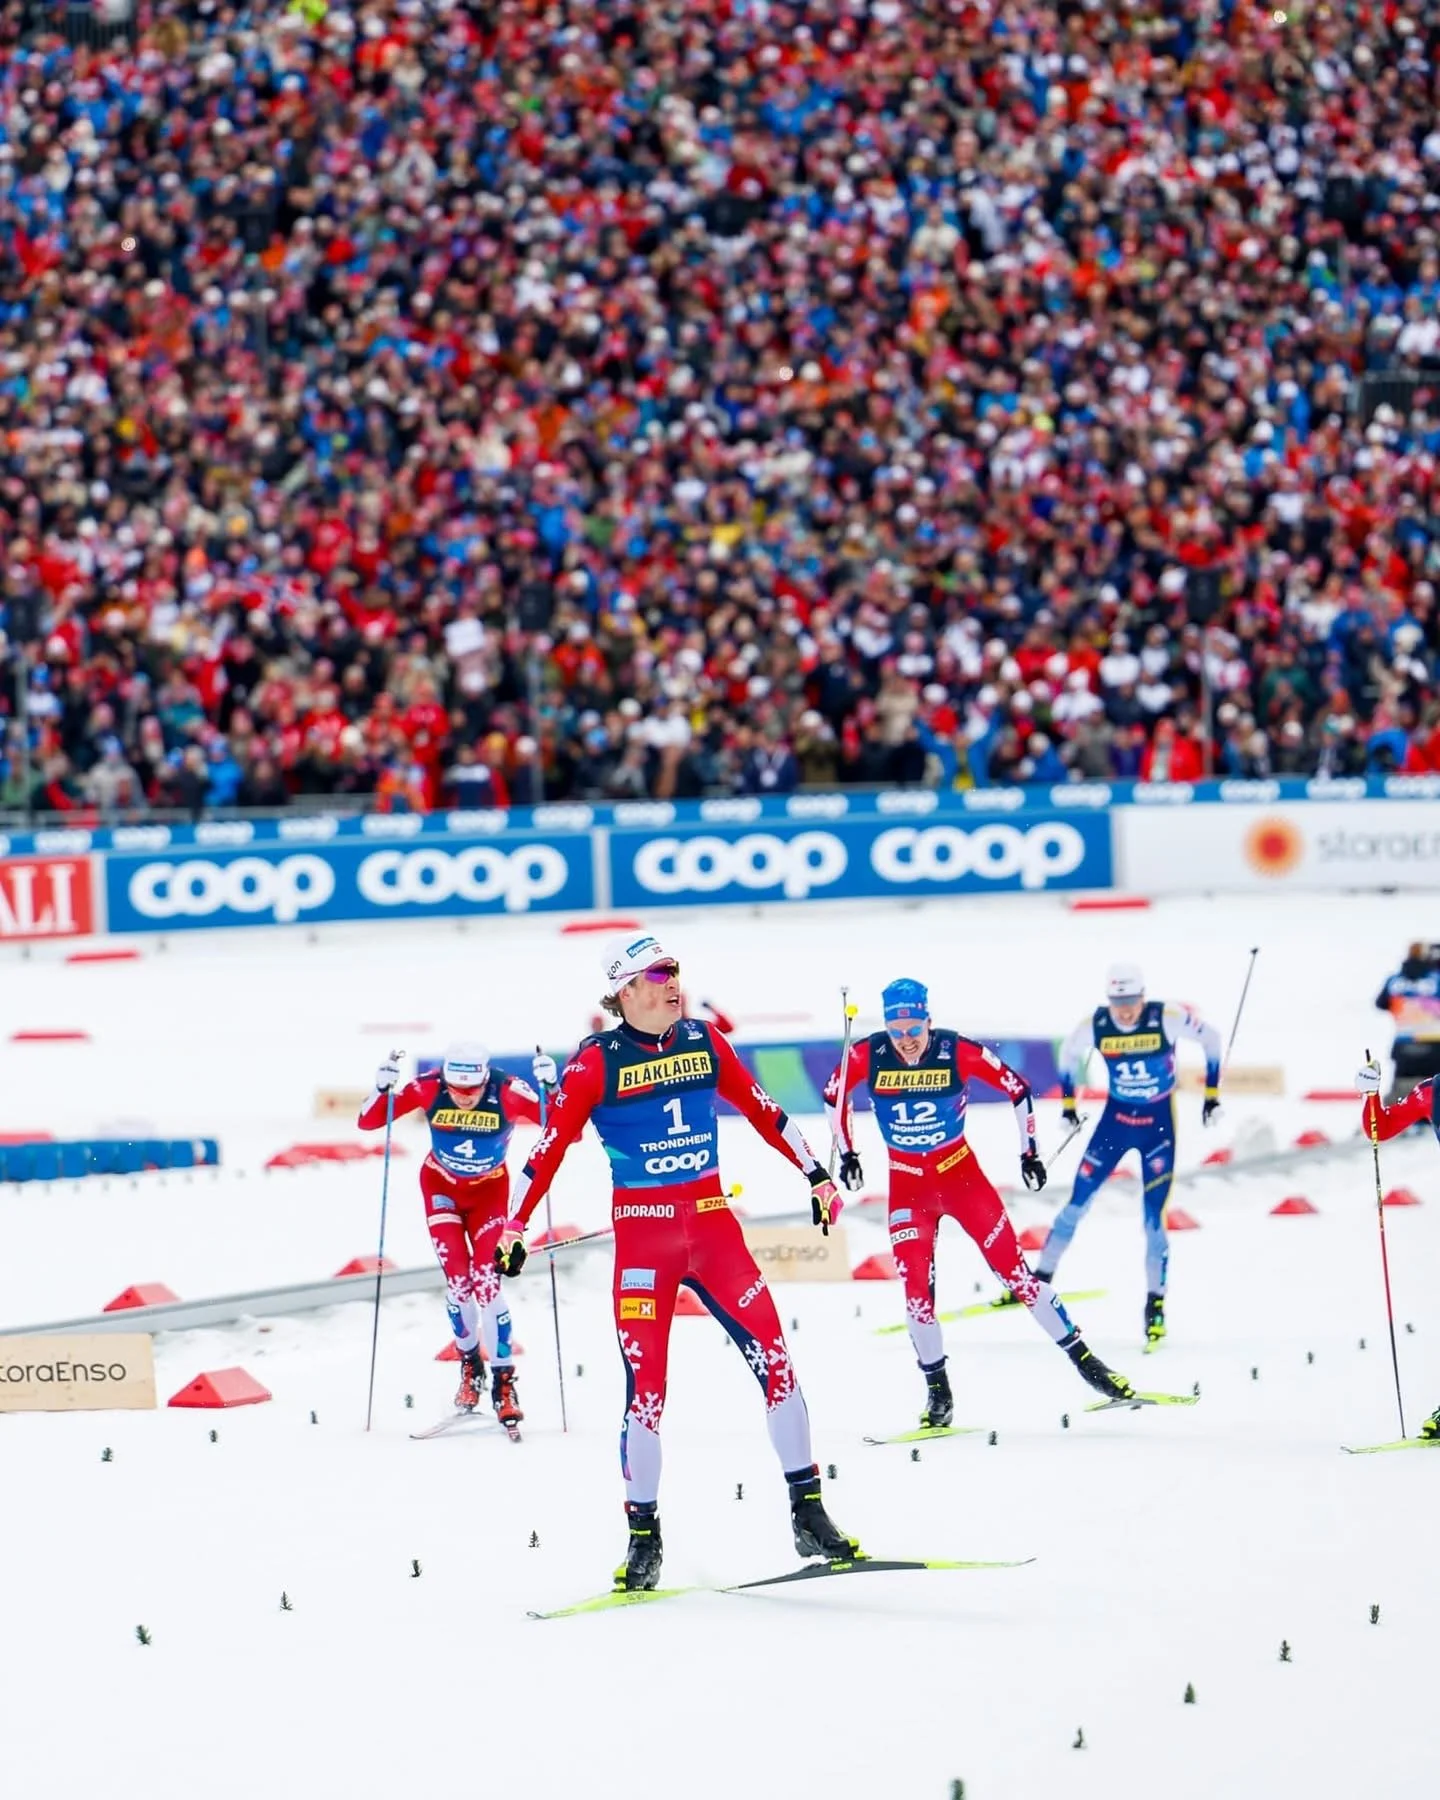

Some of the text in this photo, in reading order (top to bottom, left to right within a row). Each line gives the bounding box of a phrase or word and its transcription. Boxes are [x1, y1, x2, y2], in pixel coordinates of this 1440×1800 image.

[633, 830, 848, 899] coop
[870, 821, 1085, 889] coop
[129, 853, 334, 922] coop
[357, 843, 568, 912] coop
[623, 1055, 709, 1087] BLÅKLÄDER
[879, 1071, 948, 1087] BLÅKLÄDER
[1115, 1060, 1151, 1080] 11
[663, 1098, 691, 1135] 1
[891, 1101, 937, 1124] 12
[453, 1139, 477, 1159] 4
[640, 1132, 712, 1153] TRONDHEIM
[614, 1204, 675, 1220] ELDORADO
